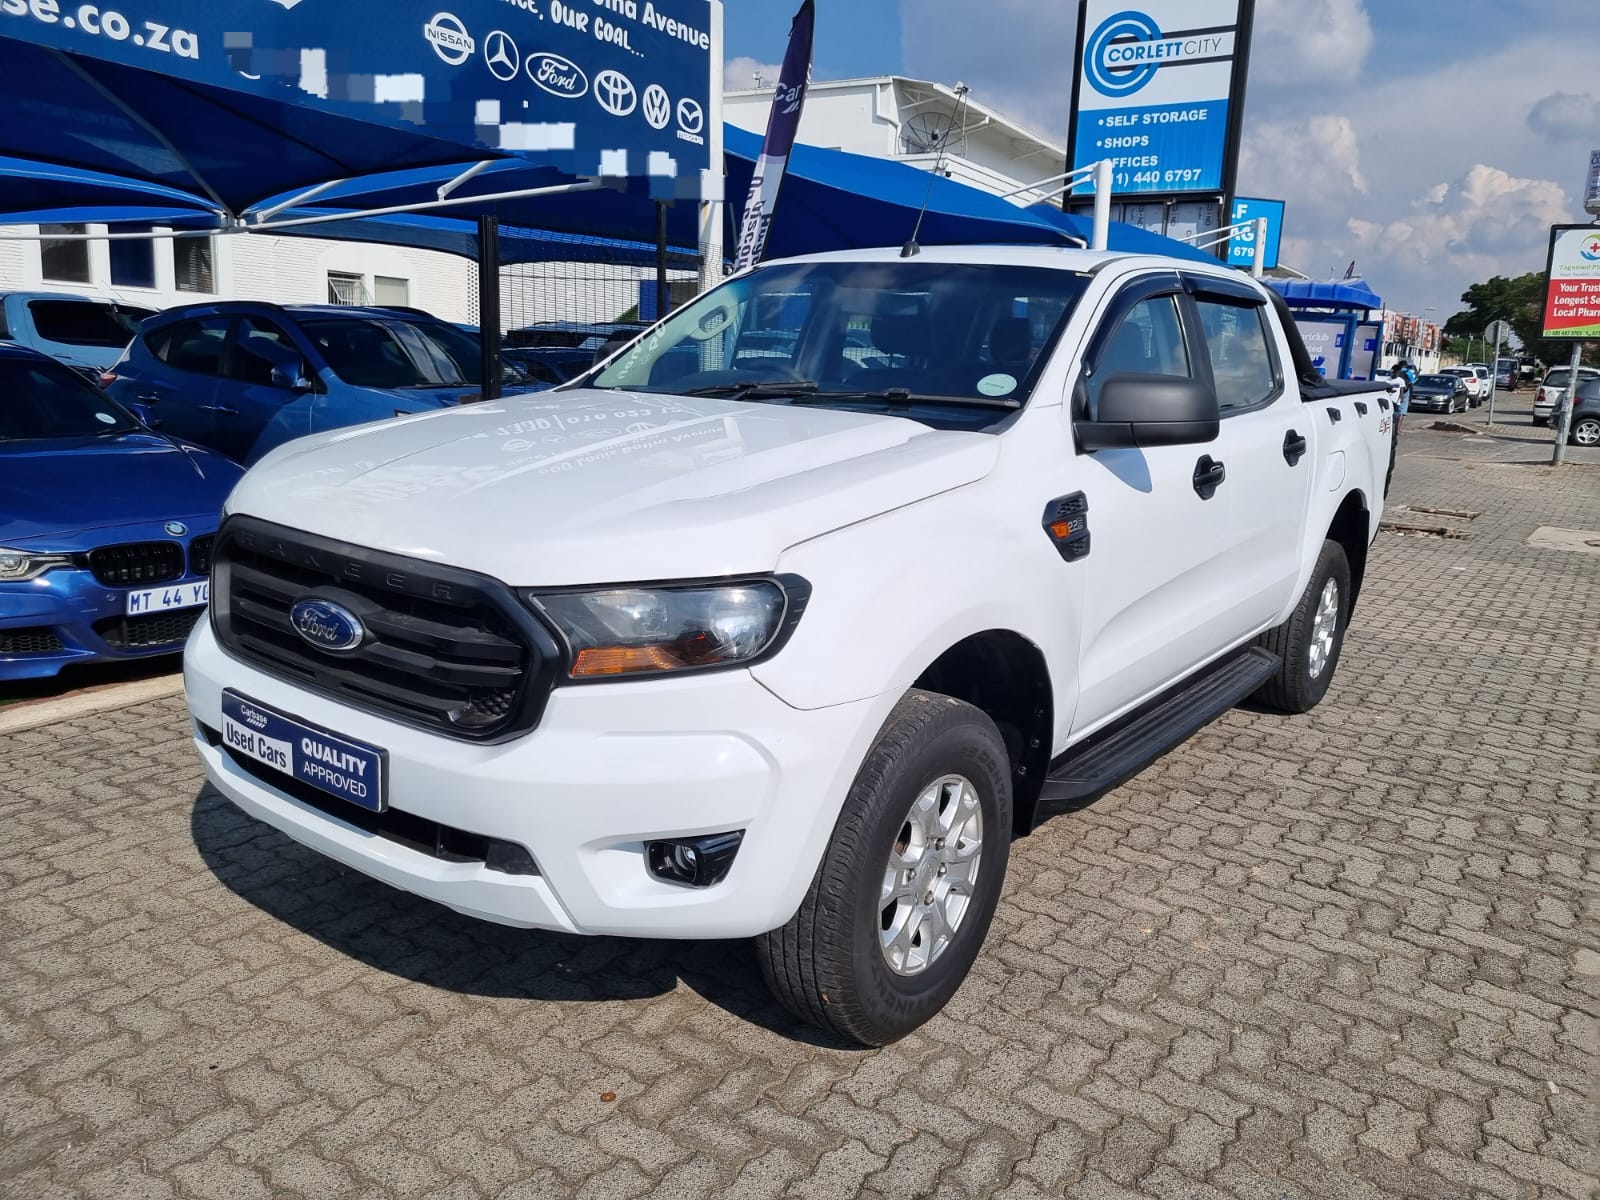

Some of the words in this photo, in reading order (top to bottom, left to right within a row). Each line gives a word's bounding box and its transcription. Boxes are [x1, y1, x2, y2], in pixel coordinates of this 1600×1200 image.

[642, 2, 710, 50] Avenue
[428, 28, 472, 49] NISSAN
[537, 58, 577, 91] Ford
[1106, 114, 1139, 127] SELF
[1142, 109, 1208, 125] STORAGE
[1103, 136, 1149, 149] SHOPS
[1133, 170, 1160, 184] 440
[1164, 168, 1202, 182] 6797
[1232, 204, 1248, 219] F
[1560, 283, 1579, 293] Your
[1554, 295, 1588, 307] Longest
[1553, 307, 1577, 317] Local
[130, 592, 152, 612] MT
[162, 588, 182, 607] 44
[300, 607, 339, 641] Ford
[241, 704, 268, 725] Carbase
[226, 722, 254, 756] Used
[258, 736, 287, 769] Cars
[301, 737, 367, 777] QUALITY
[303, 761, 367, 798] APPROVED
